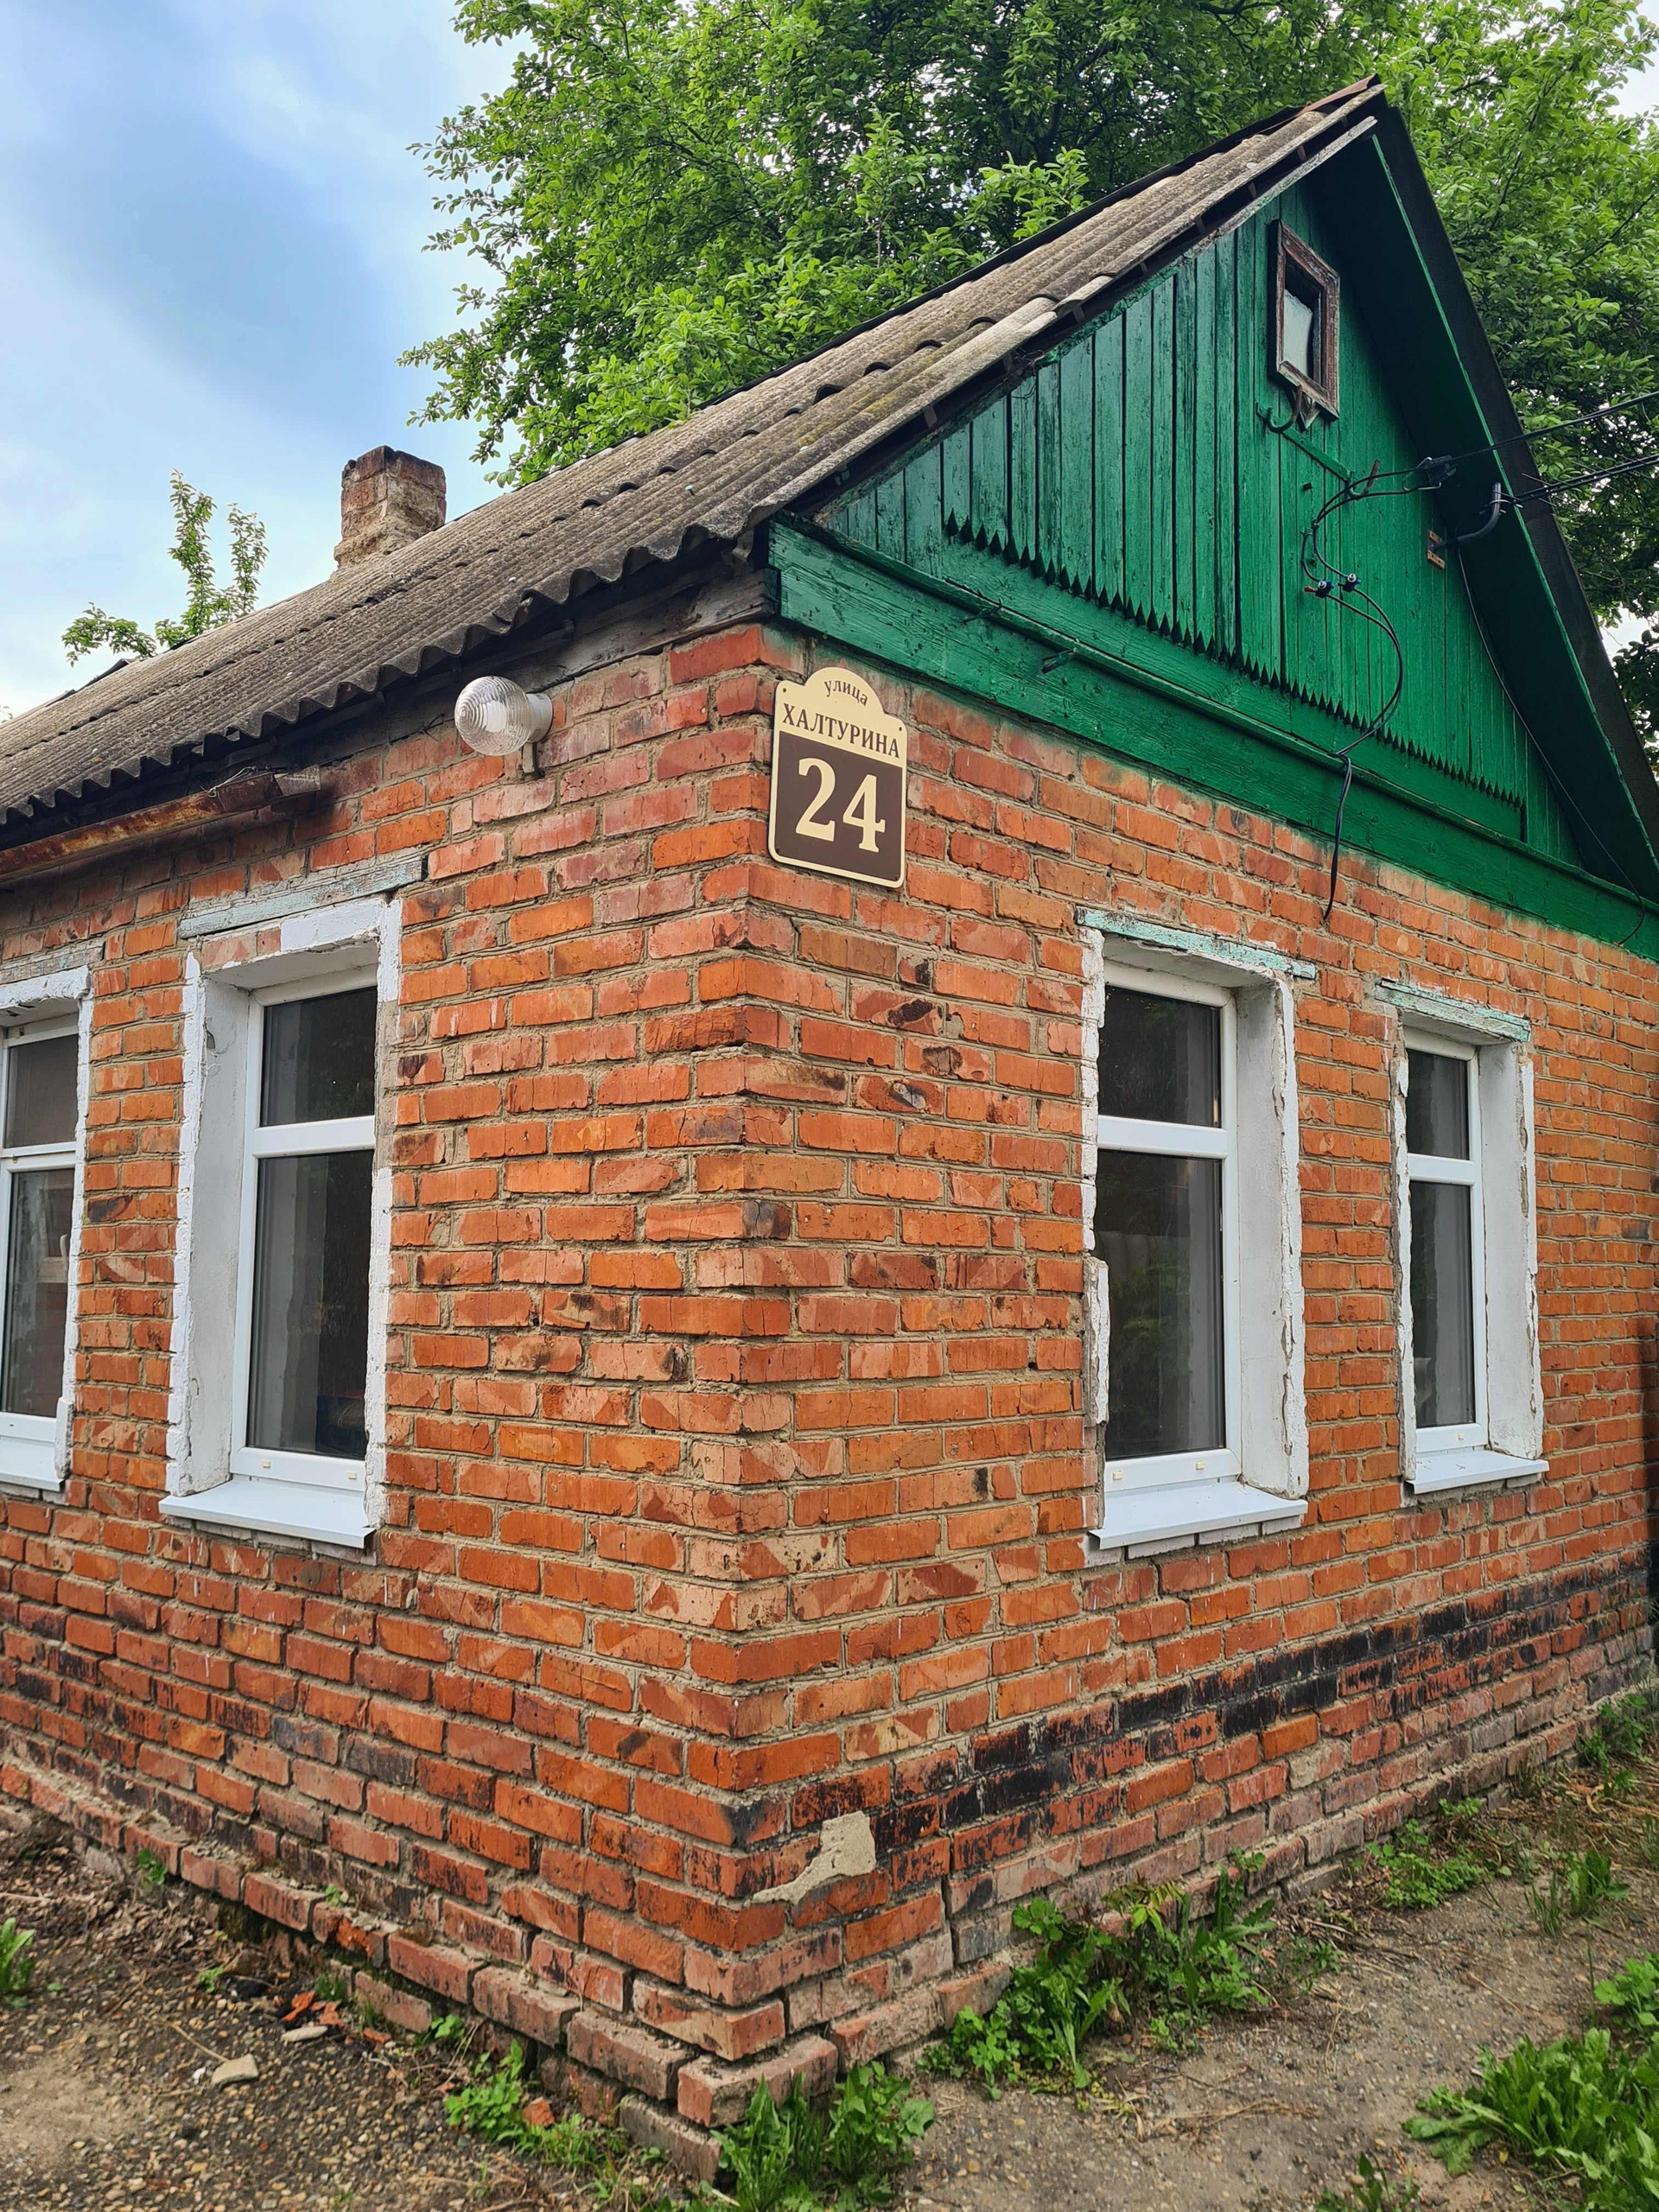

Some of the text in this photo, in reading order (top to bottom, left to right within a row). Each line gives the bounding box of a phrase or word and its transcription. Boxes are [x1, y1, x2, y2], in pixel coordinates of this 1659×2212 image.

[824, 680, 868, 706] улица
[782, 702, 900, 758] ХАЛТУРИНА
[795, 757, 886, 853] 24
